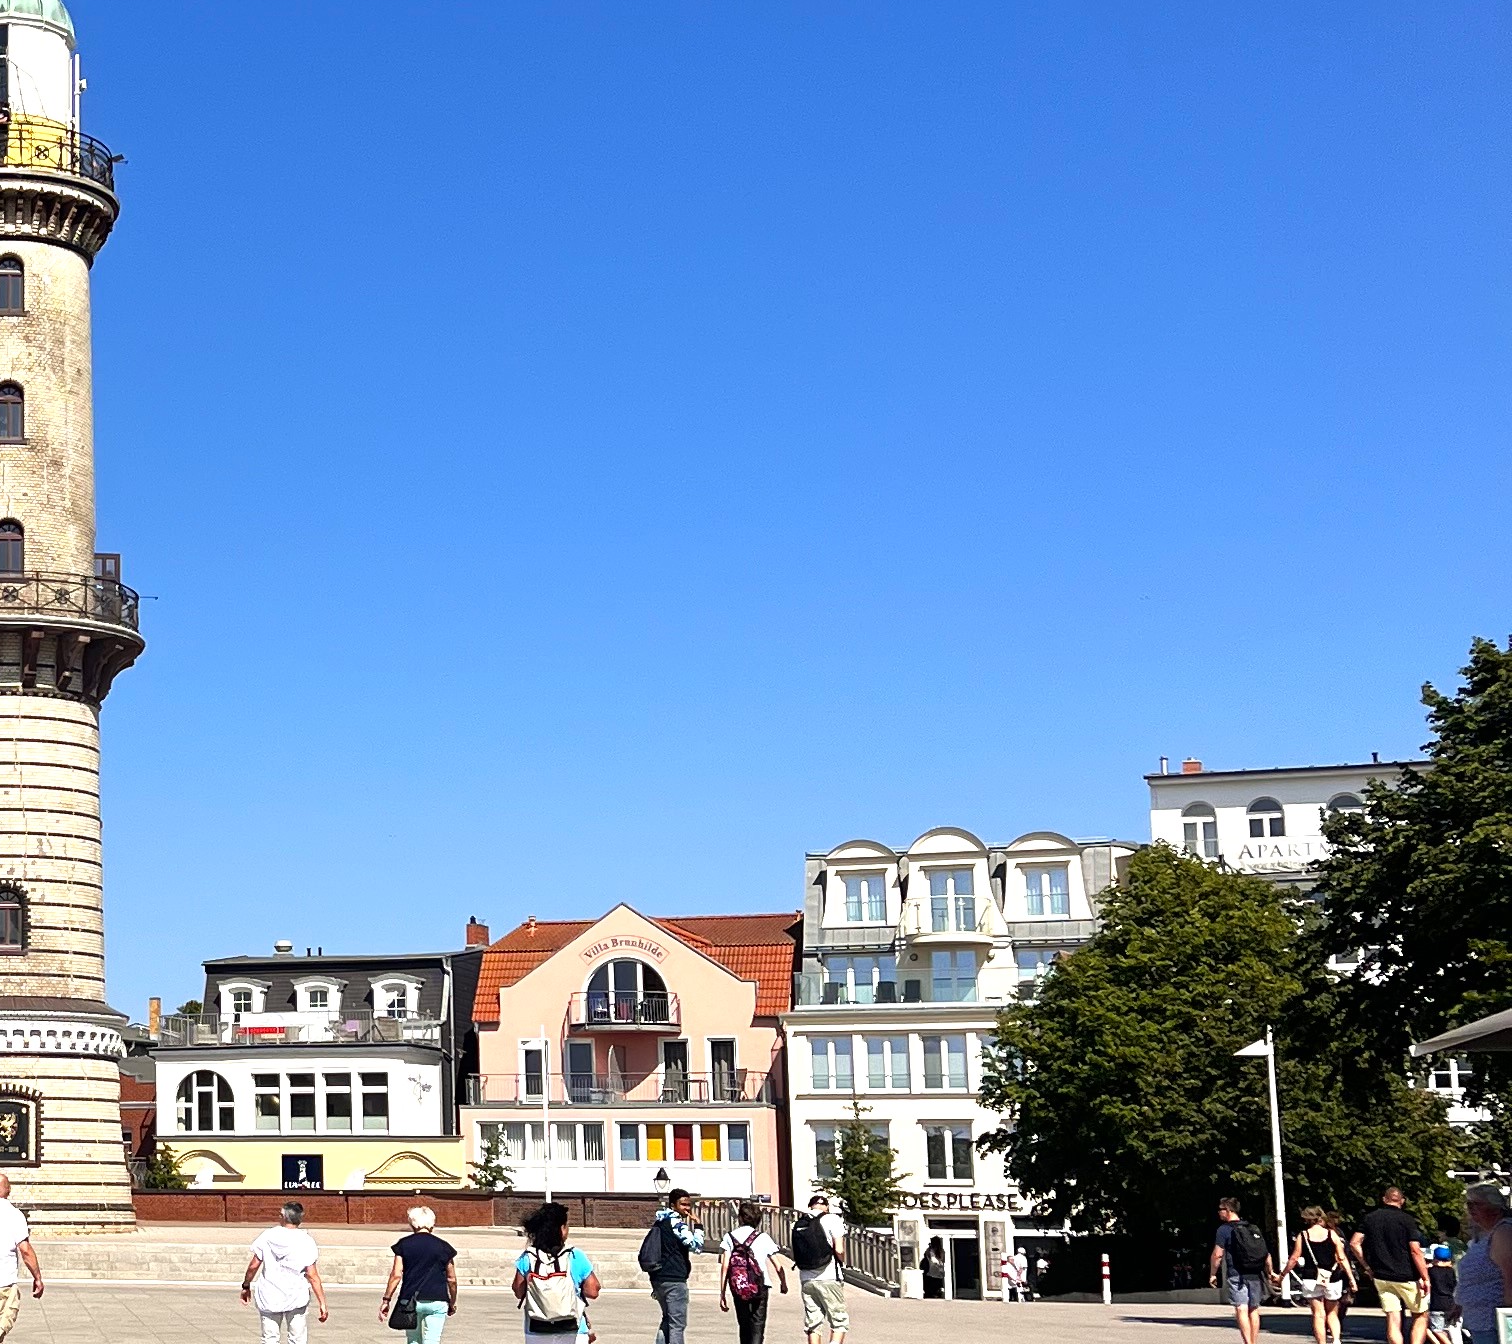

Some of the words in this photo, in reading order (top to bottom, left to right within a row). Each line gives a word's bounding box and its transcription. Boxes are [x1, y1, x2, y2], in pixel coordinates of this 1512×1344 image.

[584, 943, 609, 959] Villa
[611, 938, 663, 959] Brunhilde
[899, 1192, 1023, 1212] OES.PLEASE.
